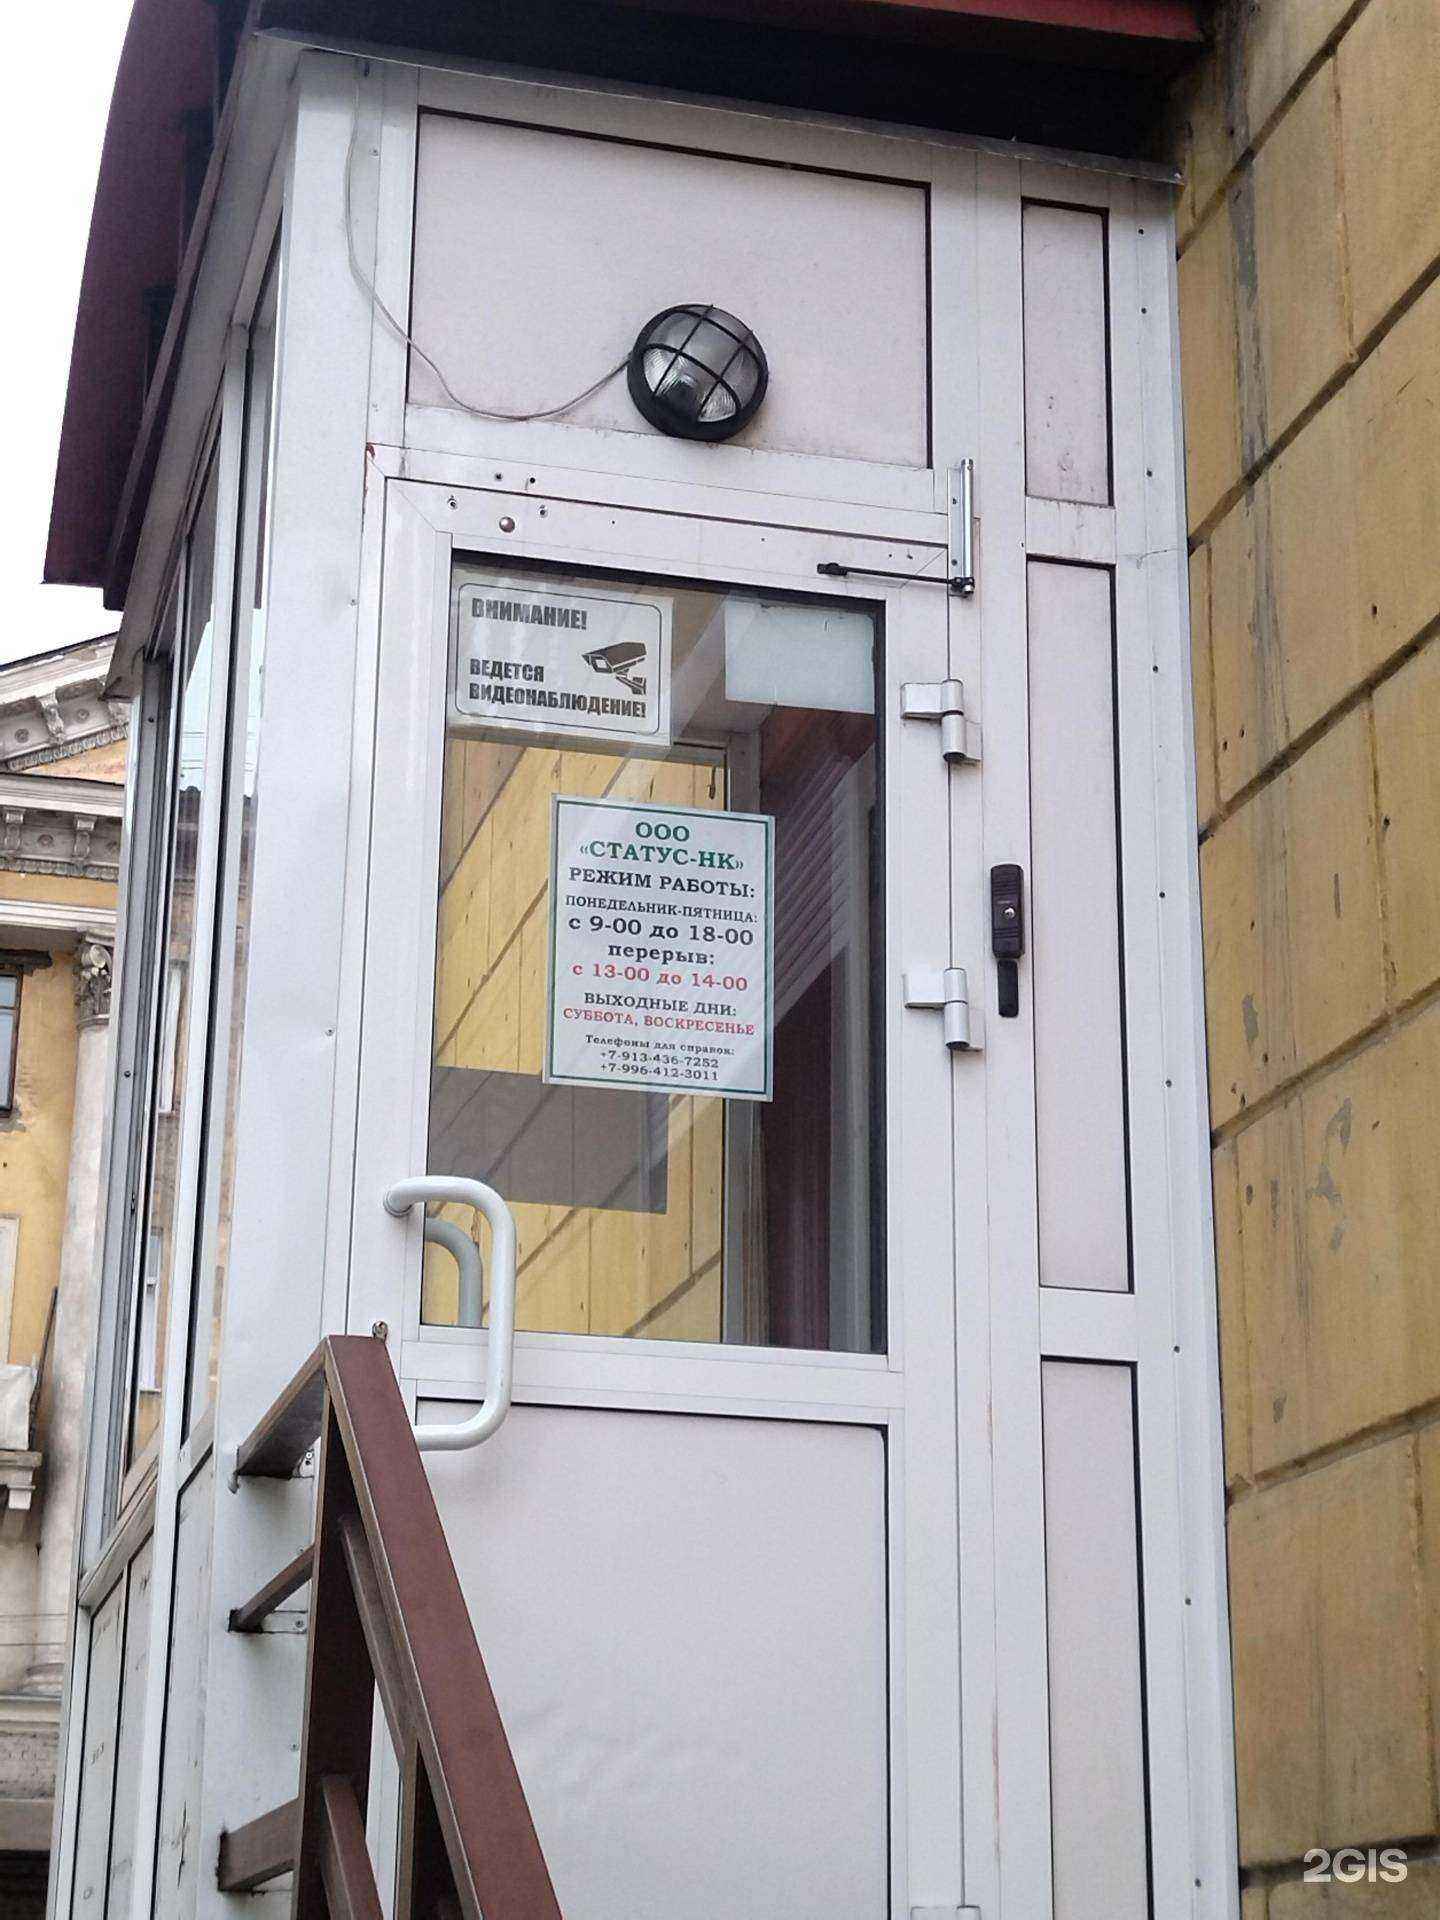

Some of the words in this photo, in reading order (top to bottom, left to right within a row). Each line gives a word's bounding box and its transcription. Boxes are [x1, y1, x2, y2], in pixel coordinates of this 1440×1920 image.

[471, 598, 587, 630] ВНИМАНИЕ!
[470, 658, 544, 682] ВЕДЕТСЯ
[469, 682, 646, 718] ВИДЕОНАБЛЮДЕНИЕ!
[635, 821, 690, 842] ООО
[579, 841, 744, 870] «СТАТУС-НК»
[569, 866, 652, 889] РЕЖИМ
[659, 876, 755, 898] РАБОТЫ:
[566, 895, 758, 924] ПОНЕДЕЛЬНИК-ПЯТНИЦА:
[568, 917, 581, 930] с
[589, 915, 642, 936] 9-00
[649, 924, 679, 940] до
[689, 925, 754, 945] 18-00
[608, 944, 715, 965] перерыв:
[572, 964, 583, 976] с
[593, 963, 650, 982] 13-00
[656, 973, 682, 986] до
[691, 972, 748, 991] 14-00
[584, 992, 689, 1012] ВЫХОДНЫЕ
[693, 1002, 737, 1017] ДНИ:
[563, 1007, 638, 1027] СУББОТА,
[644, 1016, 755, 1036] ВОСКРЕСЕНЬЕ
[586, 1034, 650, 1049] Телефоны
[653, 1041, 676, 1052] для
[680, 1042, 735, 1056] справок:
